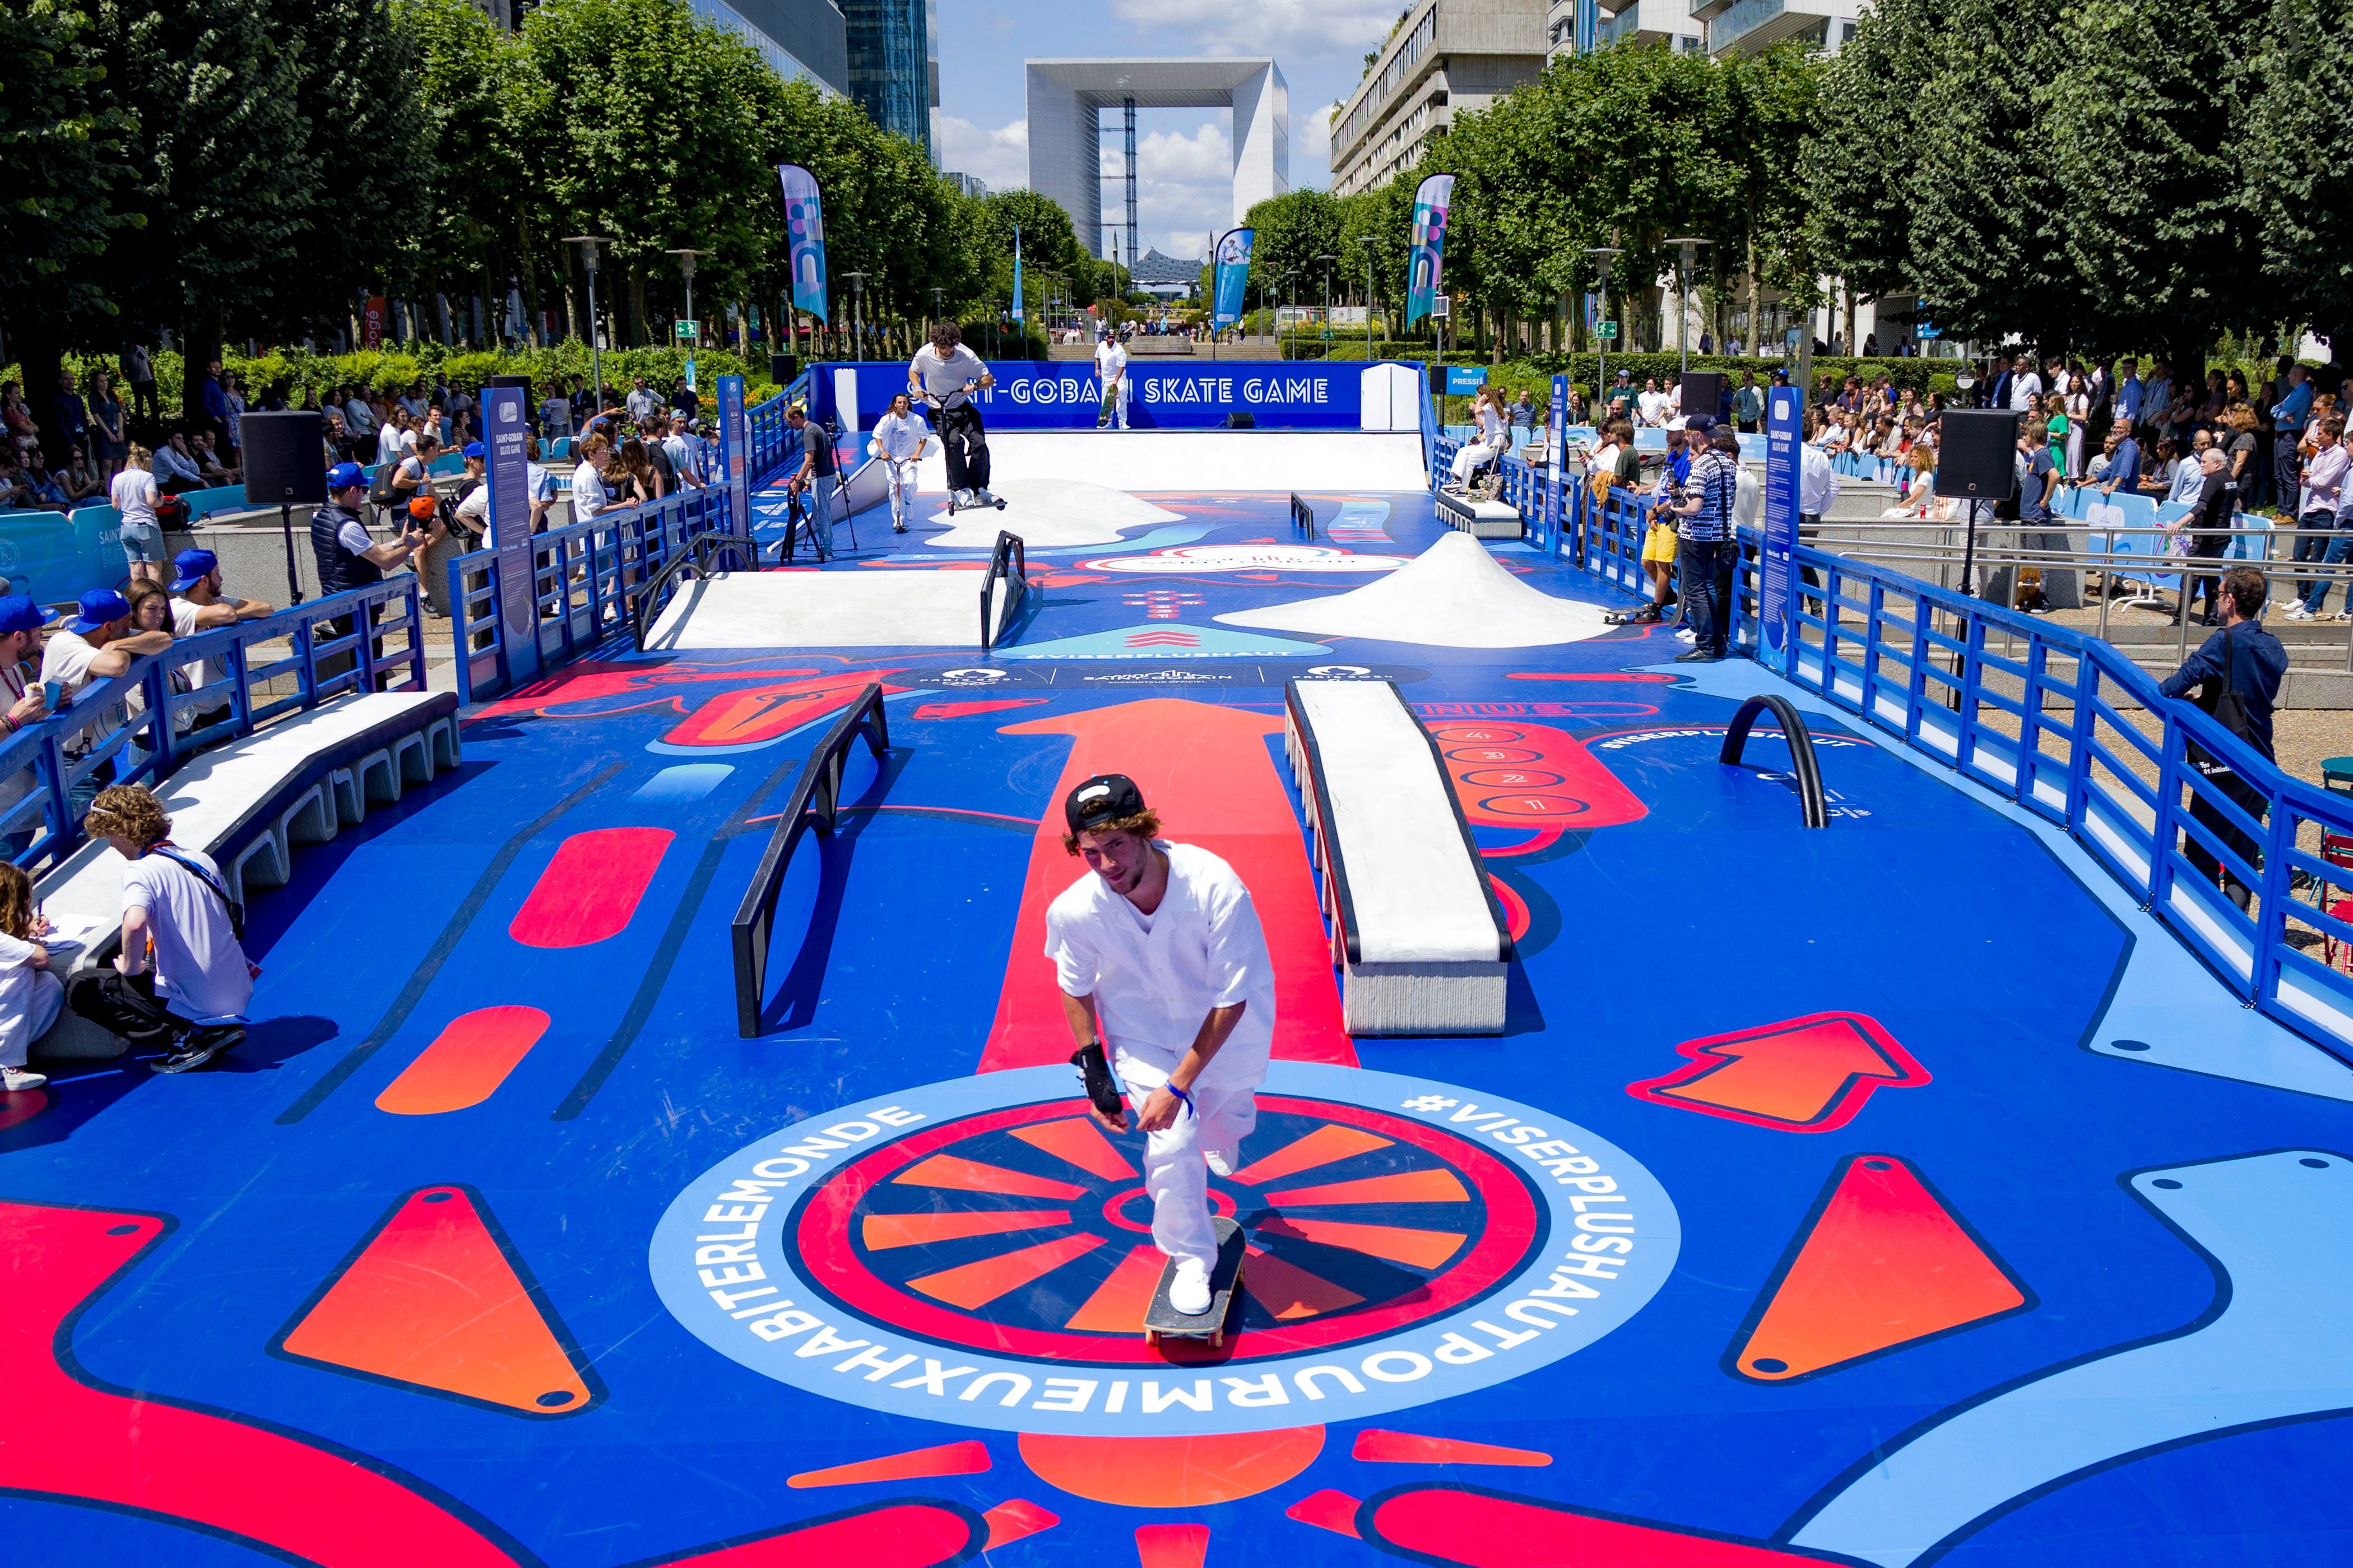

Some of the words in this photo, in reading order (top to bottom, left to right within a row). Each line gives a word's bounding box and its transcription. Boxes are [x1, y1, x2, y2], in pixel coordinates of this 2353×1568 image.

[365, 310, 380, 350] ogé
[1144, 378, 1233, 403] SKATE
[1243, 378, 1329, 403] GAME
[496, 432, 523, 444] SAINT-GOBAIN
[1770, 430, 1792, 441] SAINT-GOBAIN
[1599, 730, 1857, 749] #VISERPLSHUT
[1501, 774, 1529, 783] 2
[1524, 800, 1546, 809] 1
